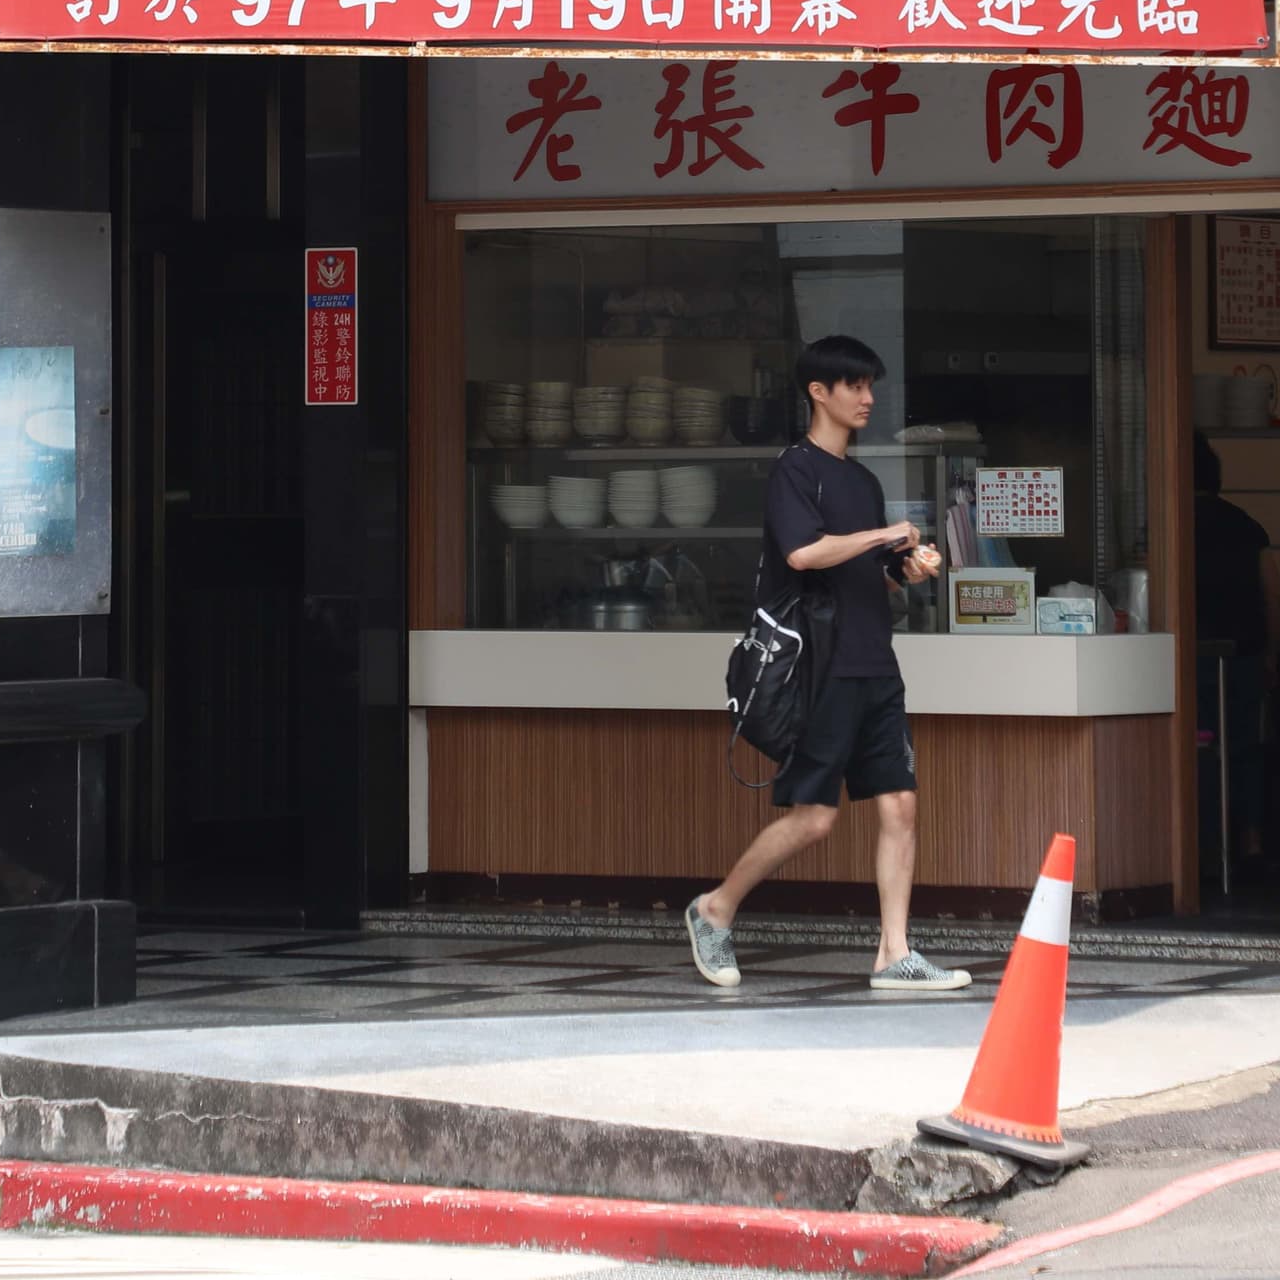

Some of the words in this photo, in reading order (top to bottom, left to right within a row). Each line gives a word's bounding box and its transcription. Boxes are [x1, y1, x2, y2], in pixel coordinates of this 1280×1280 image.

[505, 60, 1253, 178] 老張牛肉麵
[961, 586, 1004, 598] 本店使用
